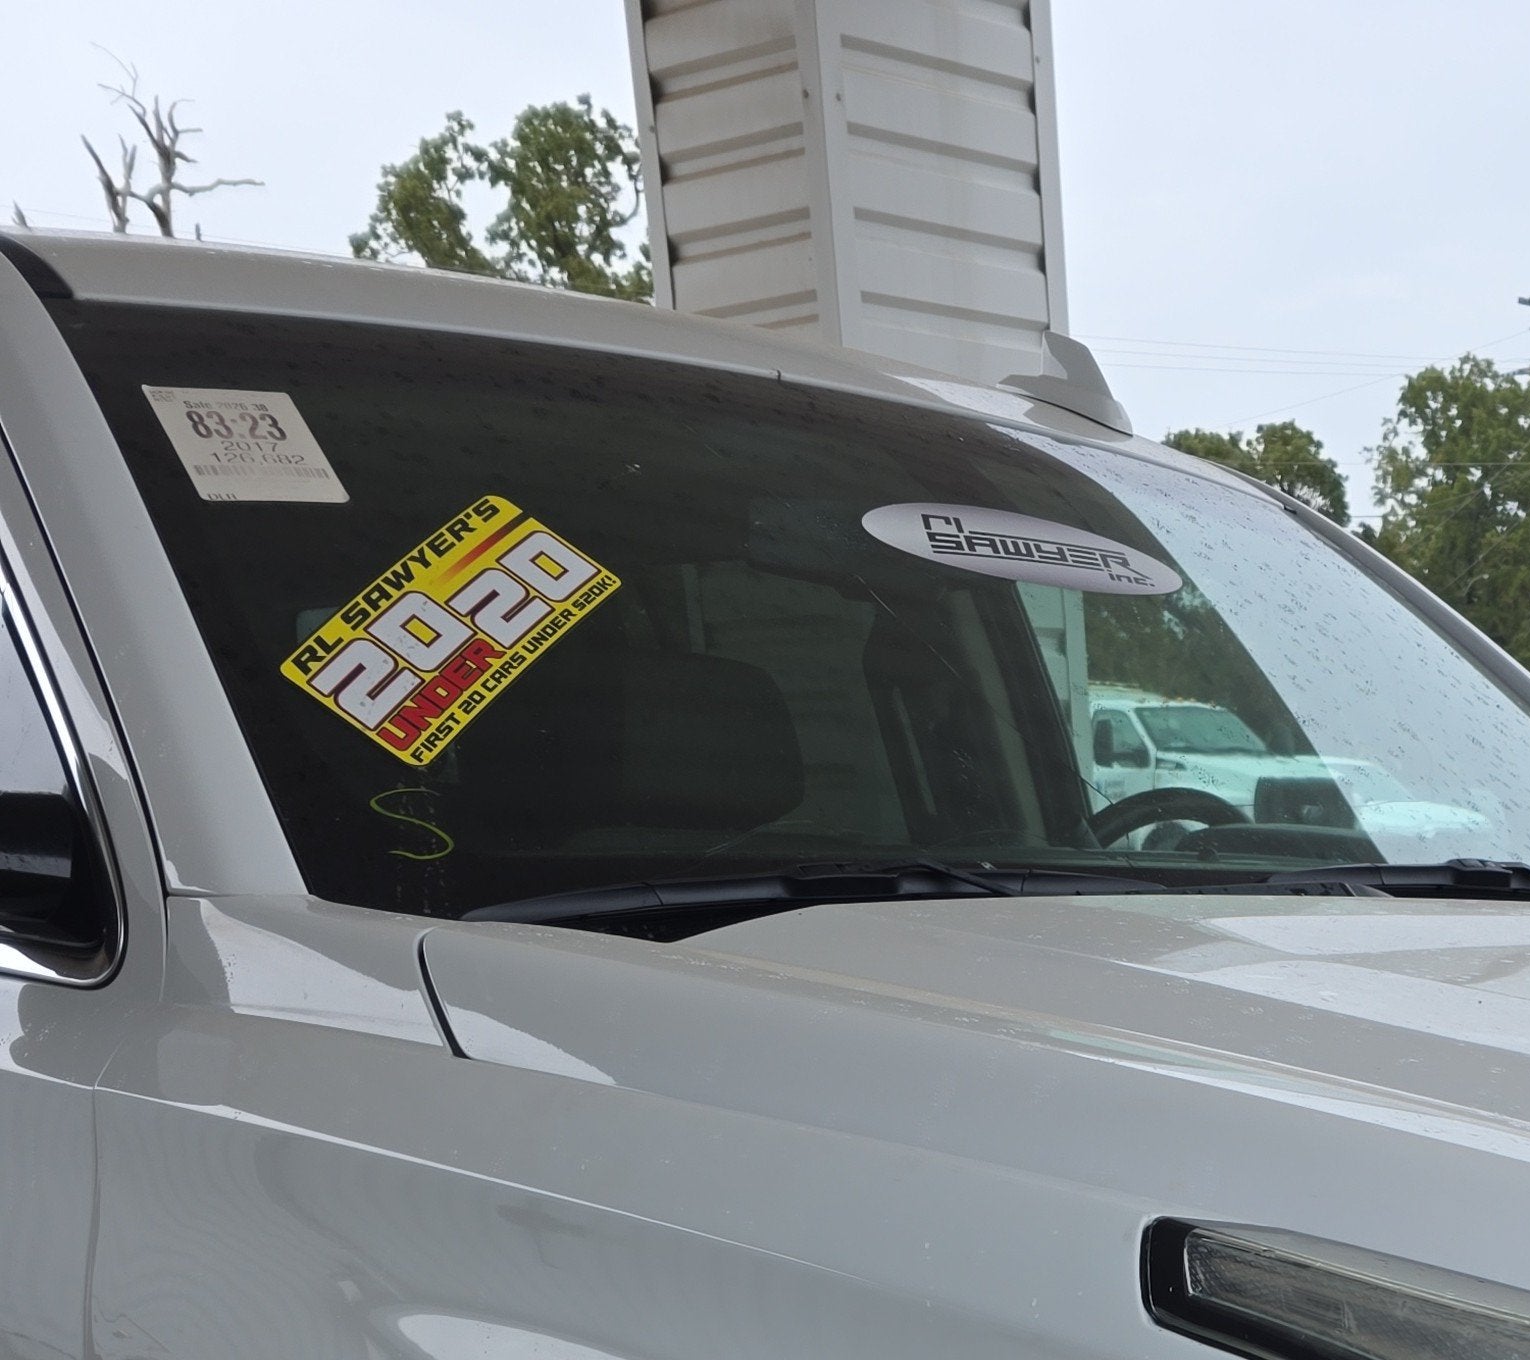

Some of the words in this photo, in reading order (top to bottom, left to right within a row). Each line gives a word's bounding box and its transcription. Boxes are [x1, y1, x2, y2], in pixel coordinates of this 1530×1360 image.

[221, 441, 278, 452] 2017
[291, 635, 344, 675] RL
[340, 498, 500, 631] SAWYER'S
[376, 638, 507, 751] UNDER
[410, 712, 461, 763] FIRST
[457, 690, 486, 725] 20
[480, 651, 527, 692] CARS
[521, 608, 577, 654] UNDER
